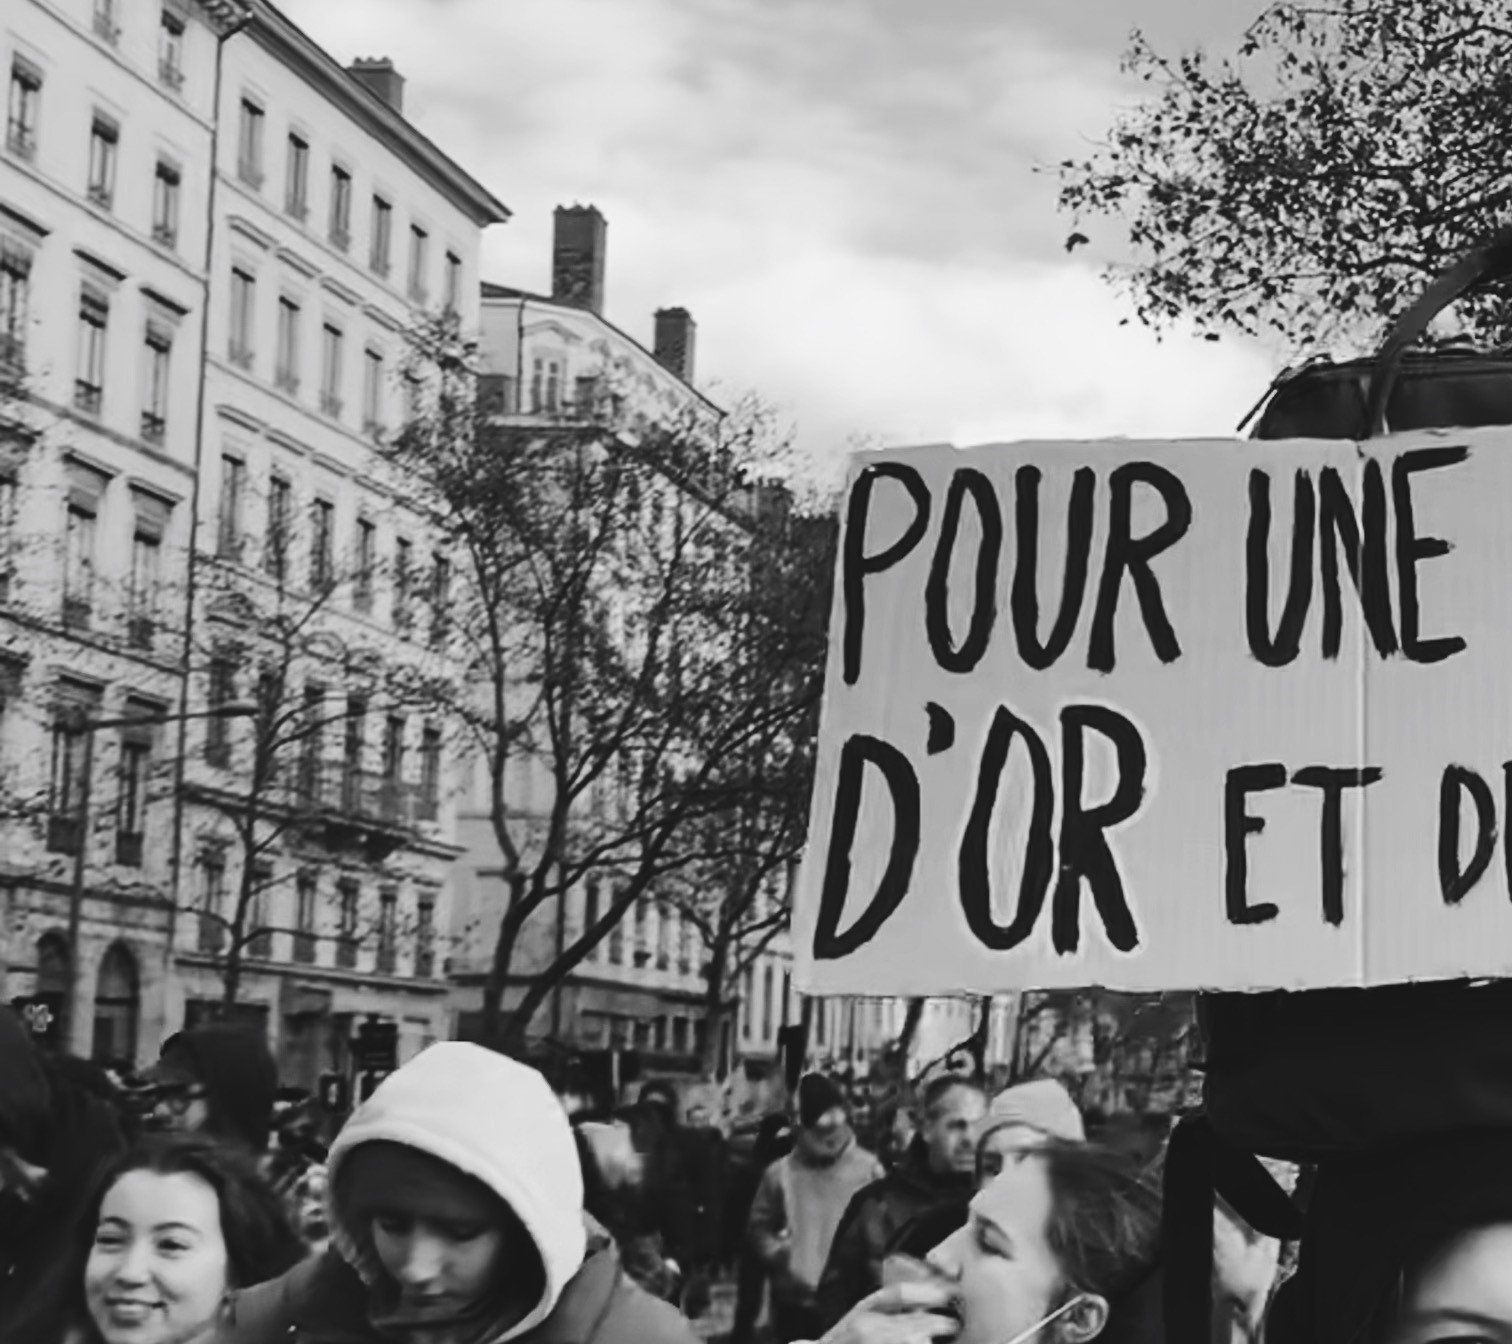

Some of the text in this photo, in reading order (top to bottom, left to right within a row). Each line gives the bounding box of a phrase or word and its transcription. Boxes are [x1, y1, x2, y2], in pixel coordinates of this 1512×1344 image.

[842, 461, 1192, 686] POUR
[1245, 446, 1471, 668] UNE
[812, 701, 1146, 959] D'OR
[1224, 763, 1383, 926] ET
